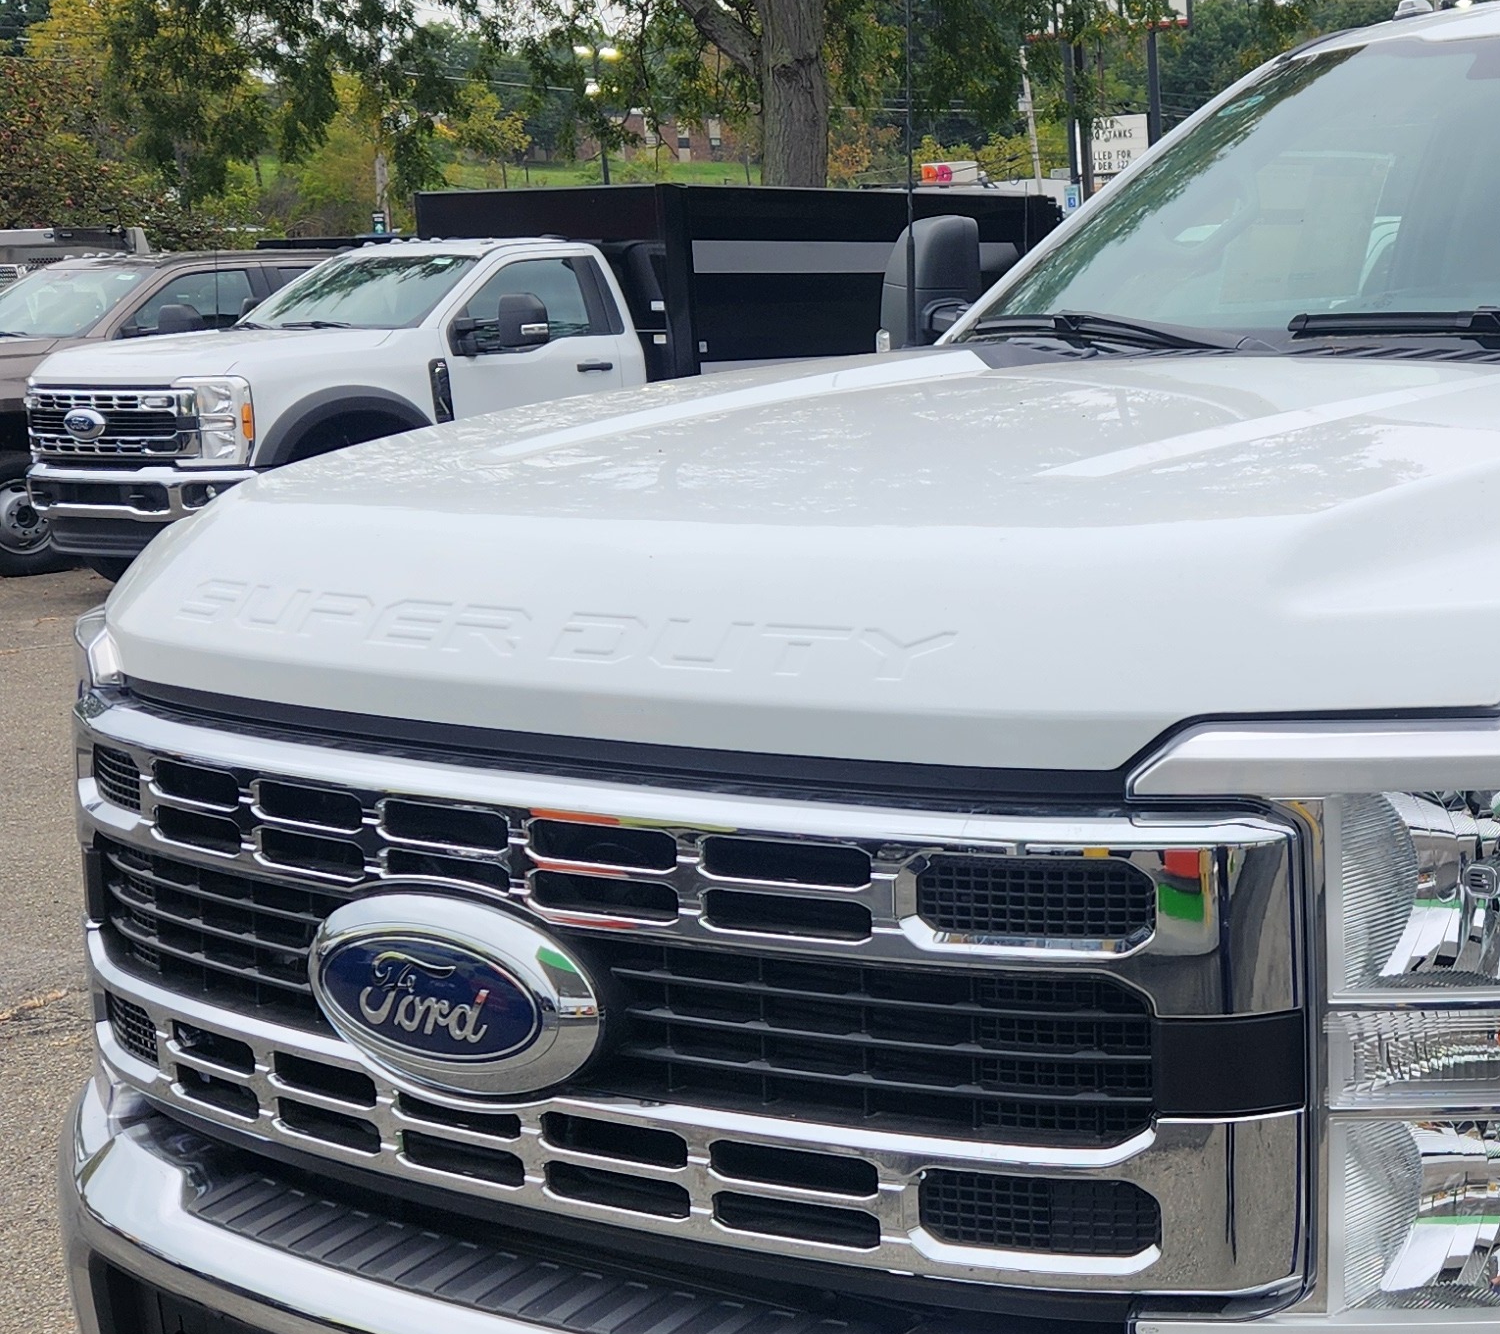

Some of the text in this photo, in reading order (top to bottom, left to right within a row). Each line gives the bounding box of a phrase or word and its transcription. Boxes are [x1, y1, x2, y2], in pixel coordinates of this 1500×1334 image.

[1108, 128, 1133, 140] TANKS
[1093, 150, 1132, 162] LLED FOR
[1093, 161, 1113, 172] DER
[174, 576, 960, 681] SUPER DUTY
[359, 950, 490, 1045] Ford
